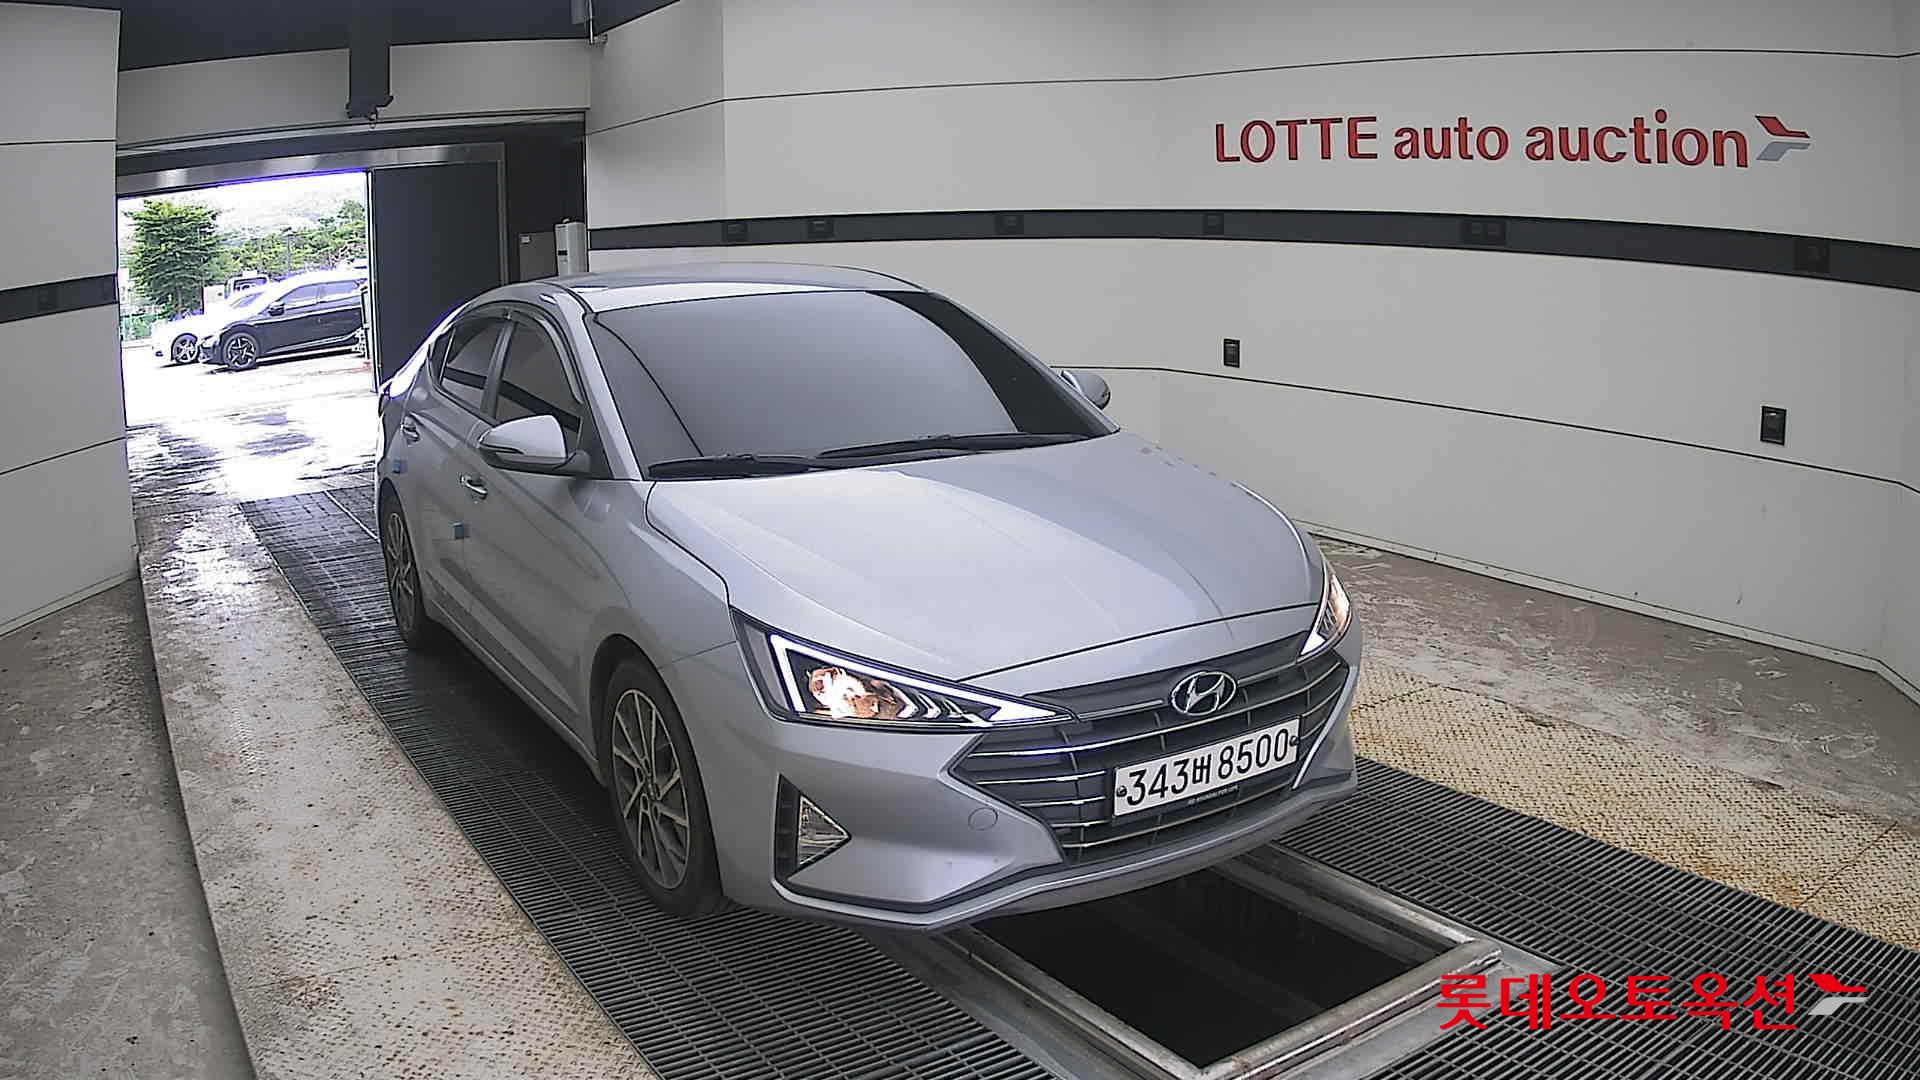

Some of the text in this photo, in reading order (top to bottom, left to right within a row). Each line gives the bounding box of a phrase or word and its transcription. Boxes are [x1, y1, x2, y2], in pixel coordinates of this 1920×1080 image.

[1214, 109, 1749, 168] LOTTE auto auction
[1217, 728, 1289, 780] 8500
